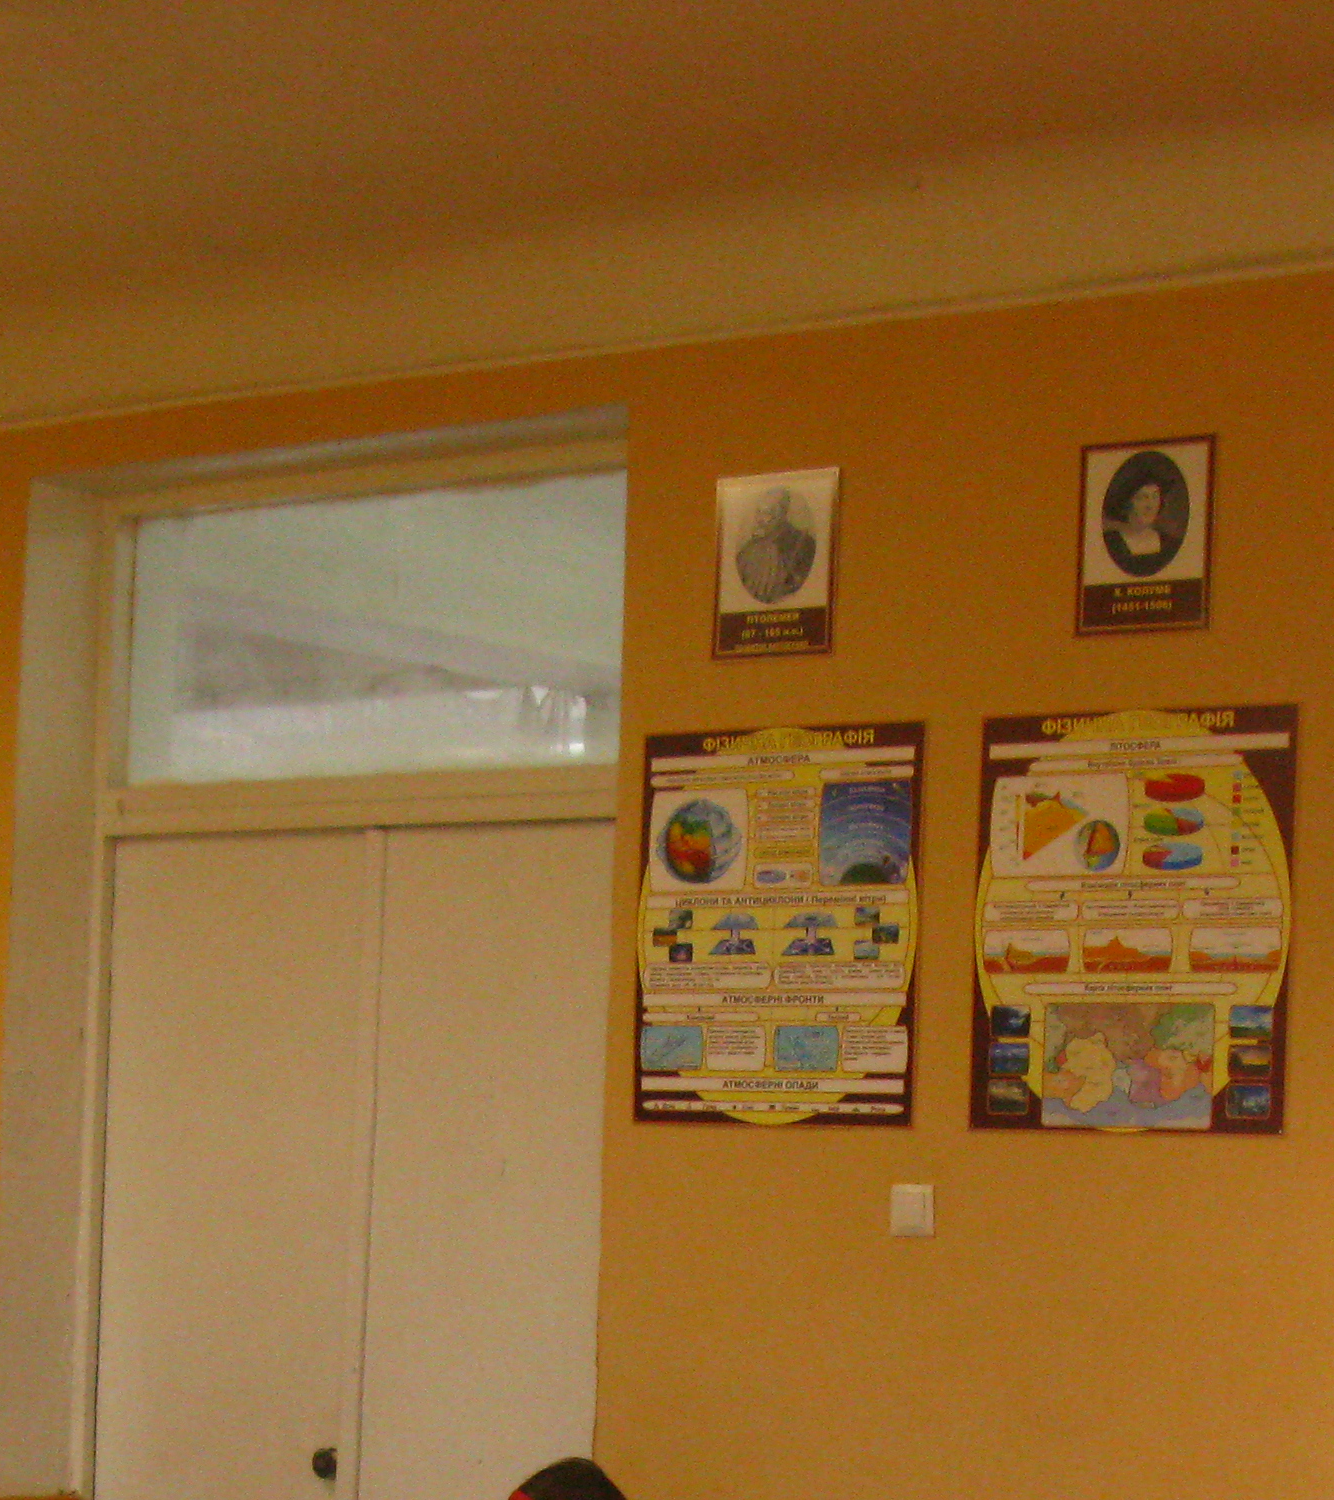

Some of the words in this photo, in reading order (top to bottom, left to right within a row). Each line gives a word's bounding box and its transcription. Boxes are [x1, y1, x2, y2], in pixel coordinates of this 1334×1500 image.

[1041, 714, 1126, 735] ФІЗИЧ
[1130, 710, 1235, 731] РАФІЯ
[702, 733, 779, 752] ФІЗИА
[782, 728, 876, 748] ГРАФІЯ
[747, 753, 811, 767] АТМОСФЕРА
[722, 994, 783, 1005] АТМОСФЕРНІ
[785, 993, 825, 1005] ФРОНТИ
[722, 1080, 783, 1091] АТМОСФЕРНІ
[785, 1080, 819, 1091] ОПАДИ
